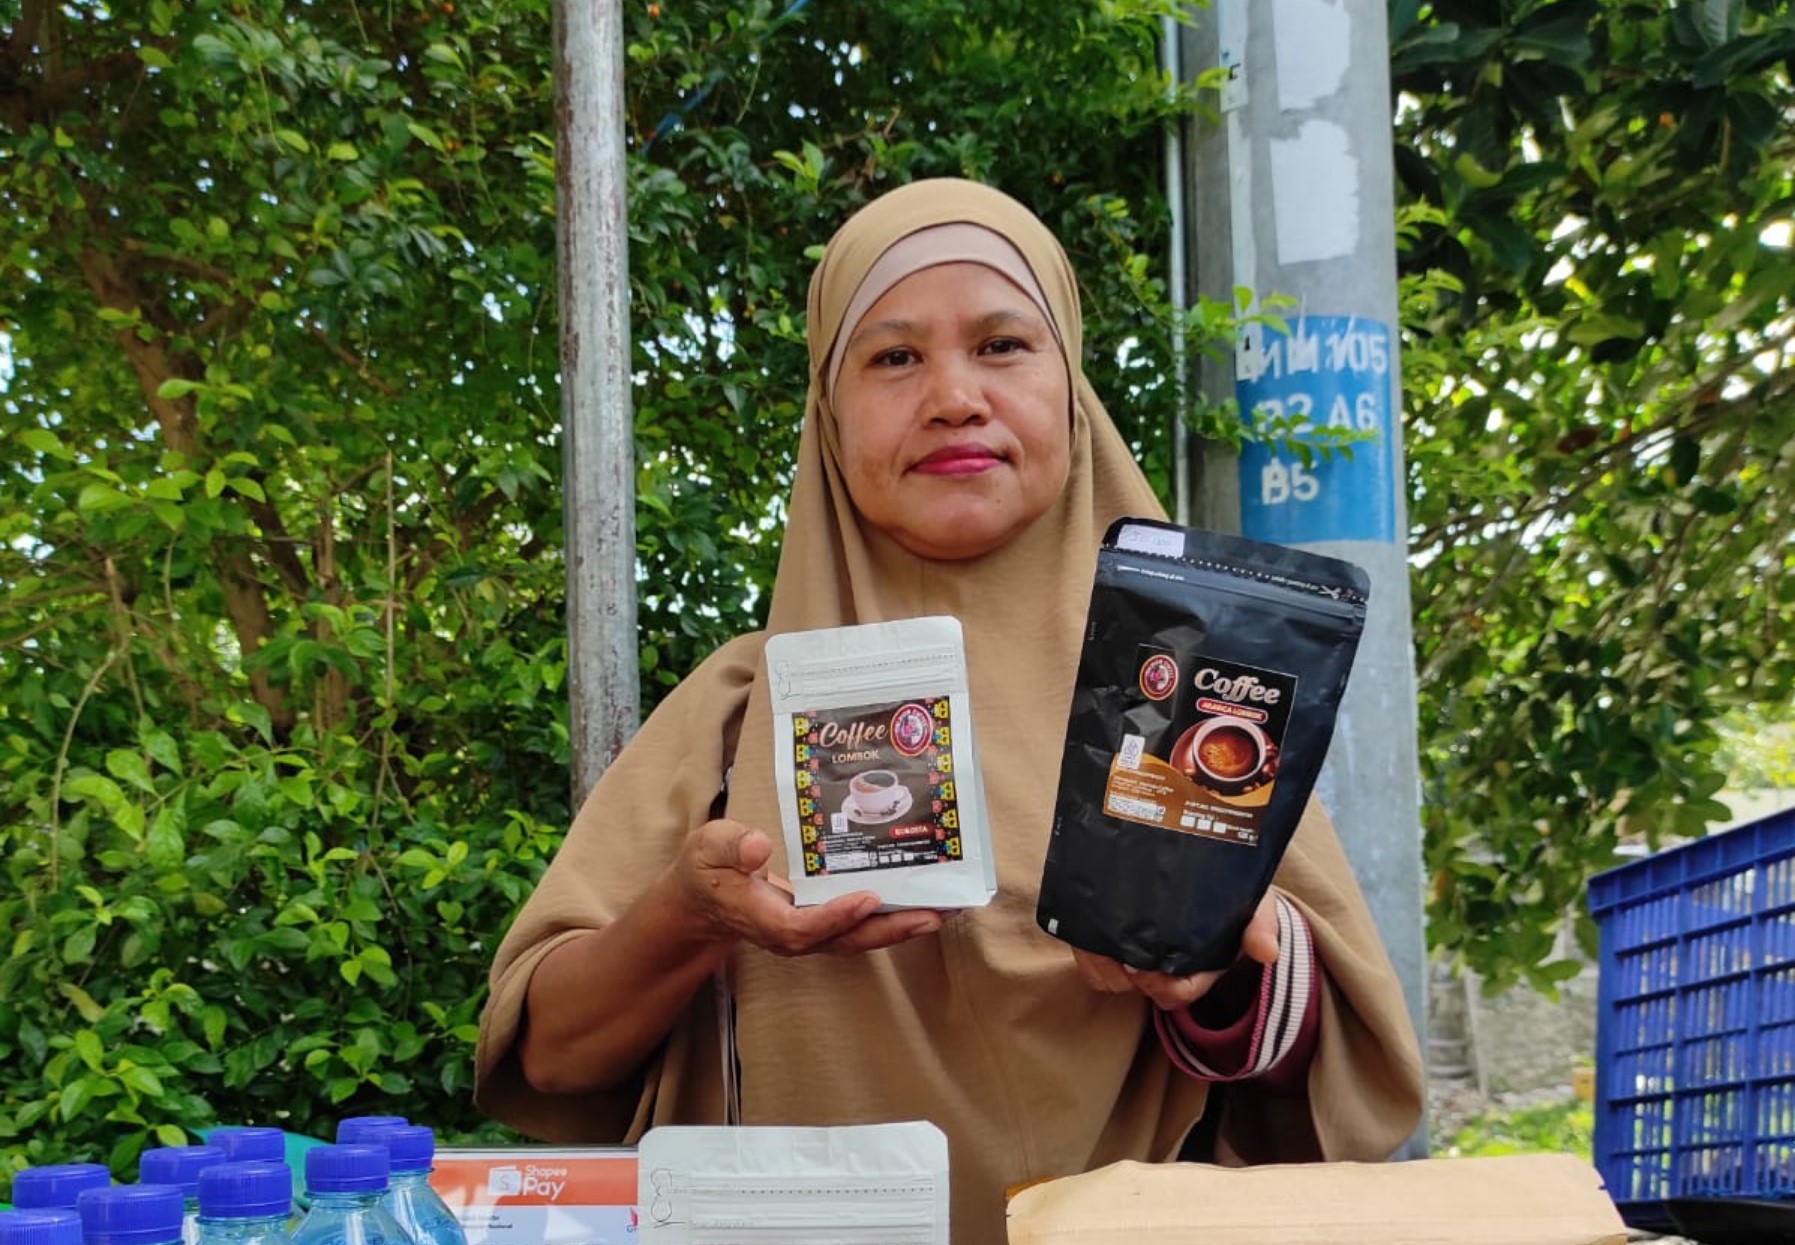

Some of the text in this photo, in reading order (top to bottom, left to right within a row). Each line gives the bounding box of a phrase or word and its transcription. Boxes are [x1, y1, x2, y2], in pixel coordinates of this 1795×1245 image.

[1328, 393, 1377, 431] A6
[1194, 668, 1282, 704] Coffee
[819, 721, 888, 749] Coffee
[831, 750, 881, 764] LOMBOK
[525, 1164, 568, 1181] Shopee
[523, 1176, 567, 1201] Pay
